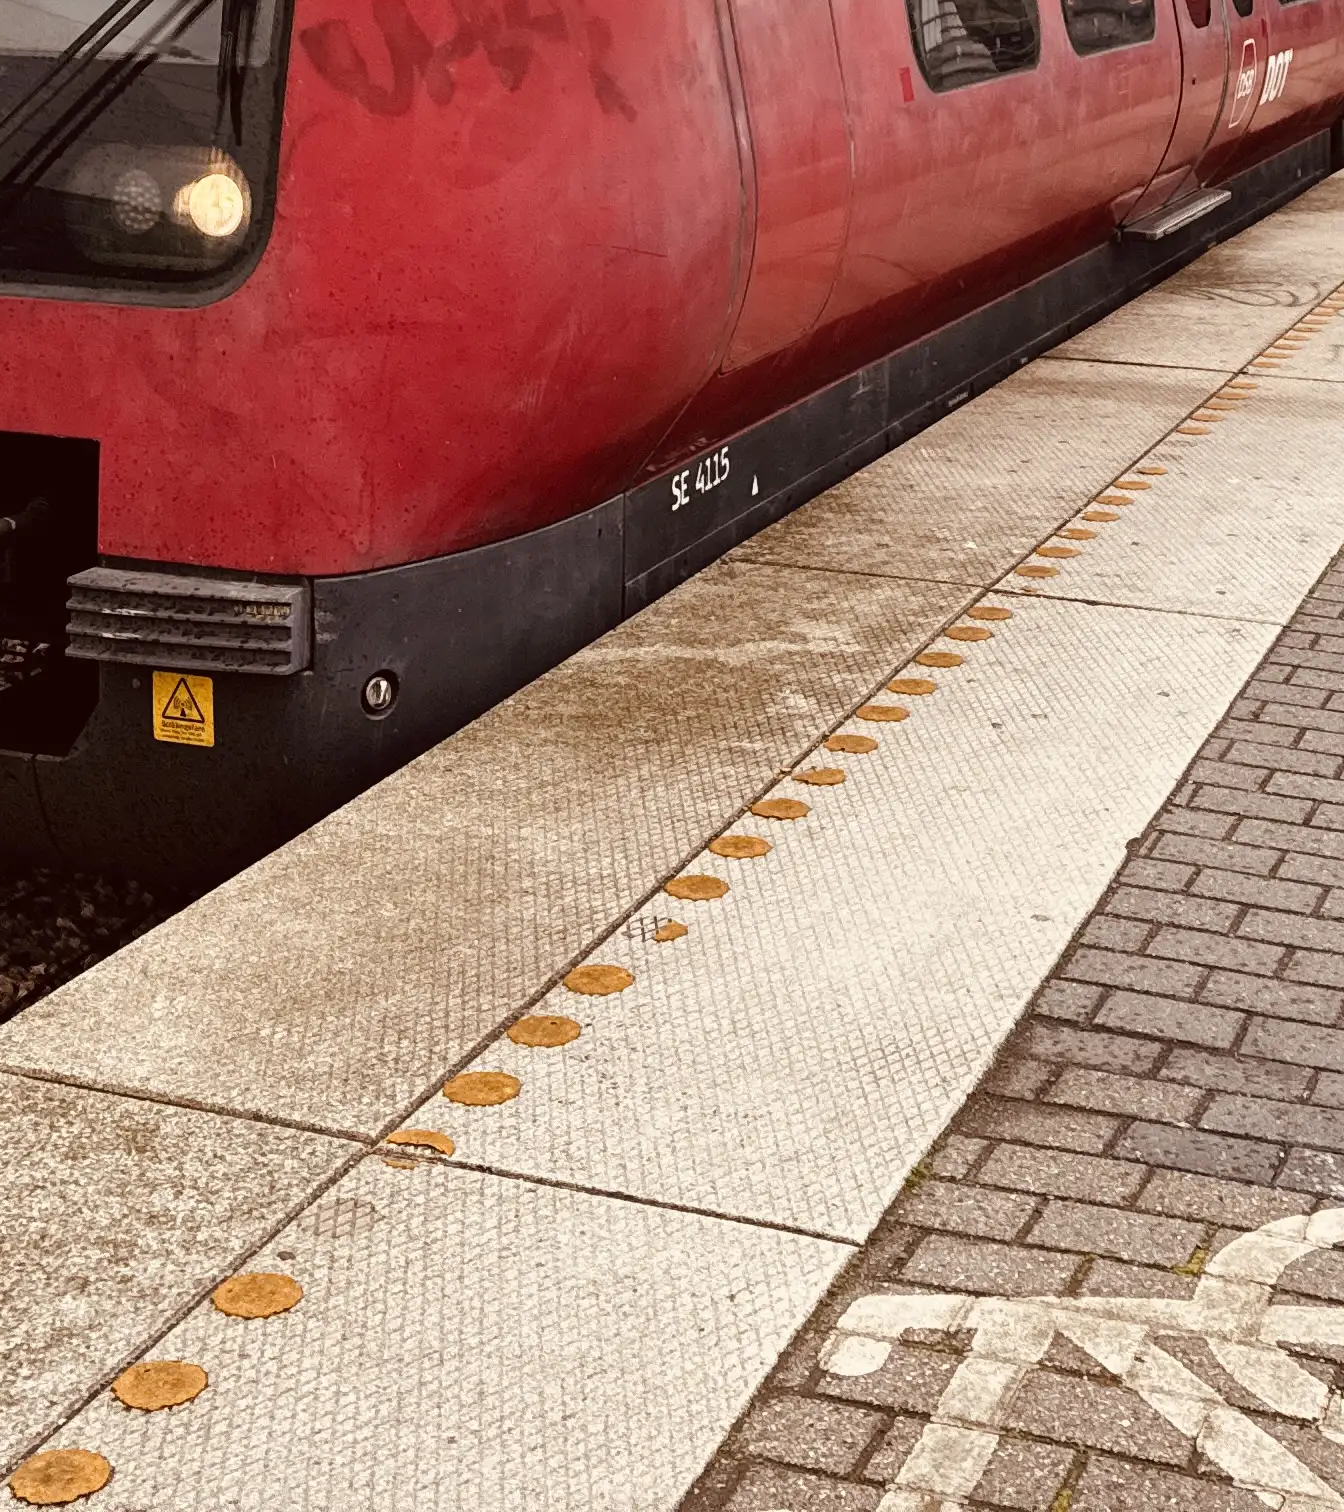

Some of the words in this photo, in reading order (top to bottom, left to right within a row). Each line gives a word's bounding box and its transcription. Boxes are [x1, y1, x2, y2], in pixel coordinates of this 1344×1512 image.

[1237, 69, 1255, 99] DSB
[671, 469, 690, 511] SE
[695, 446, 730, 494] 4115
